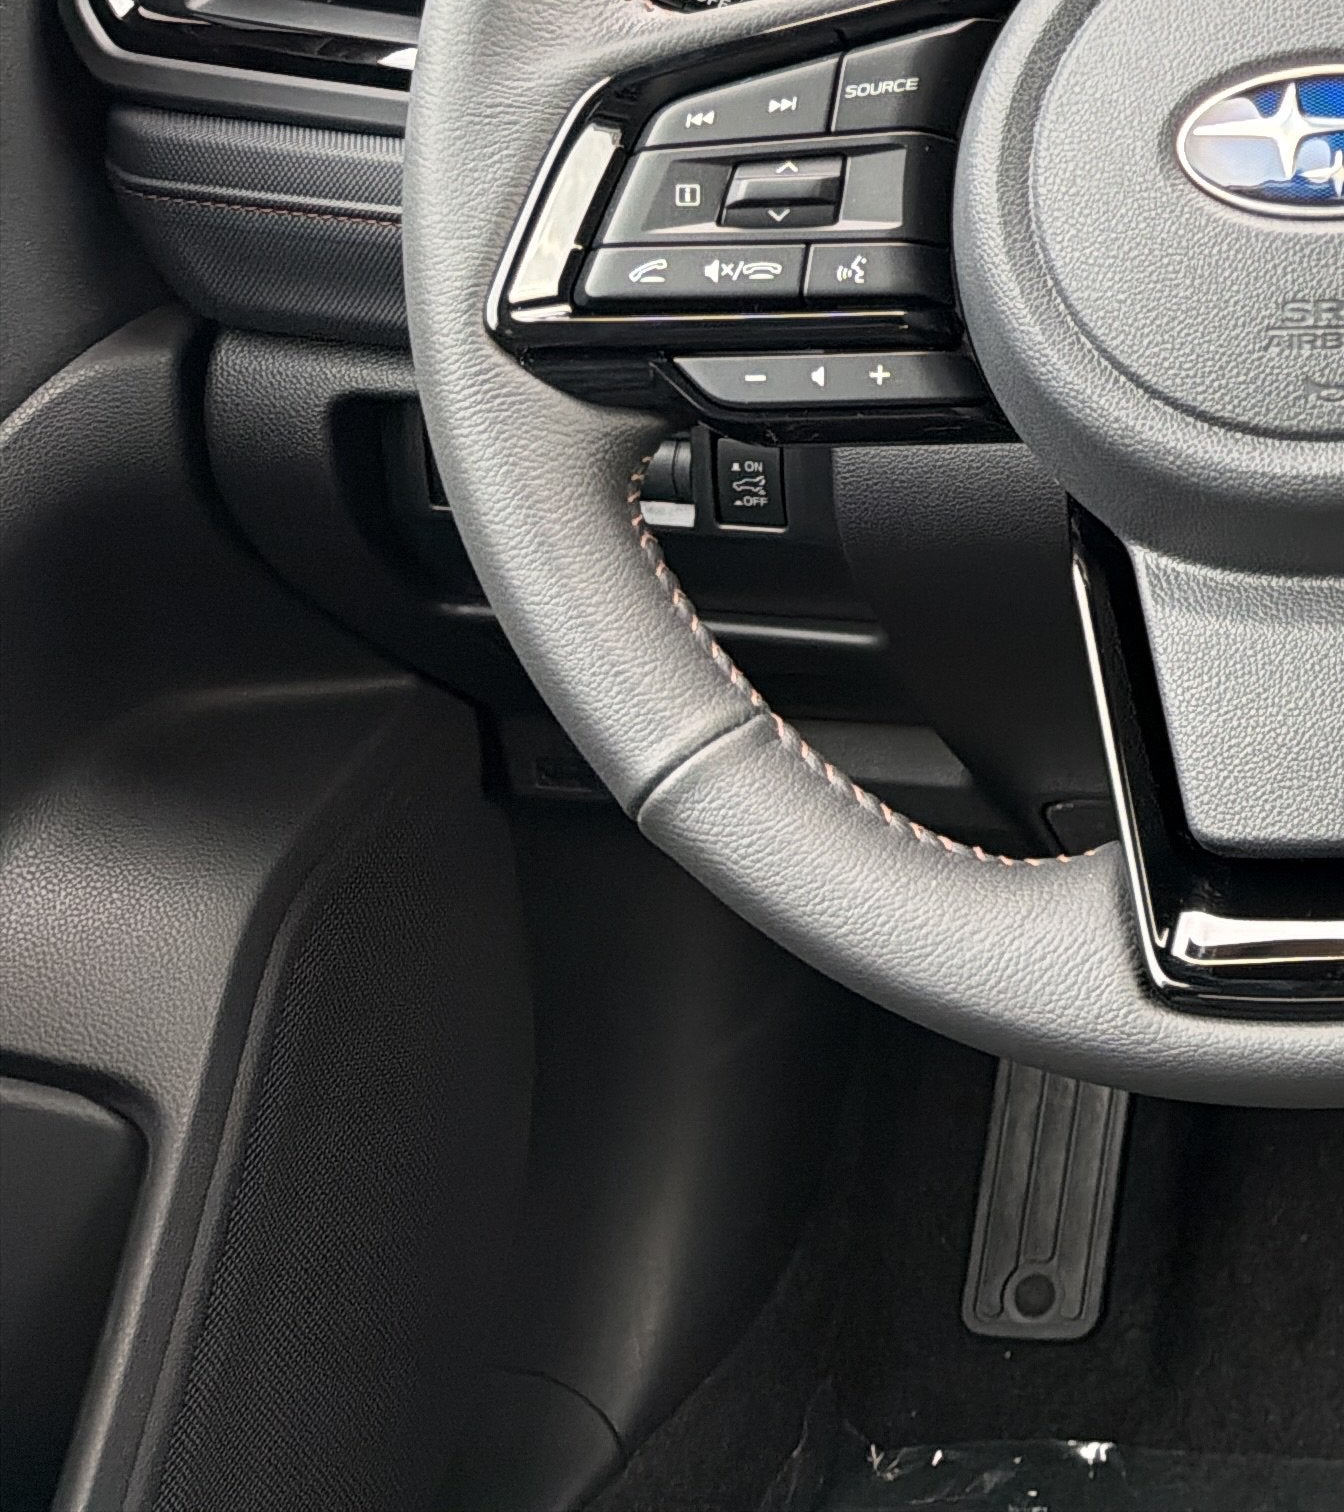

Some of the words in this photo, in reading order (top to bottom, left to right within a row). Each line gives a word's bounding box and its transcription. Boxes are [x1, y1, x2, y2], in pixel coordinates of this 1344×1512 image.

[844, 76, 919, 99] SOURCE
[743, 460, 763, 473] ON
[743, 495, 769, 507] OFF
